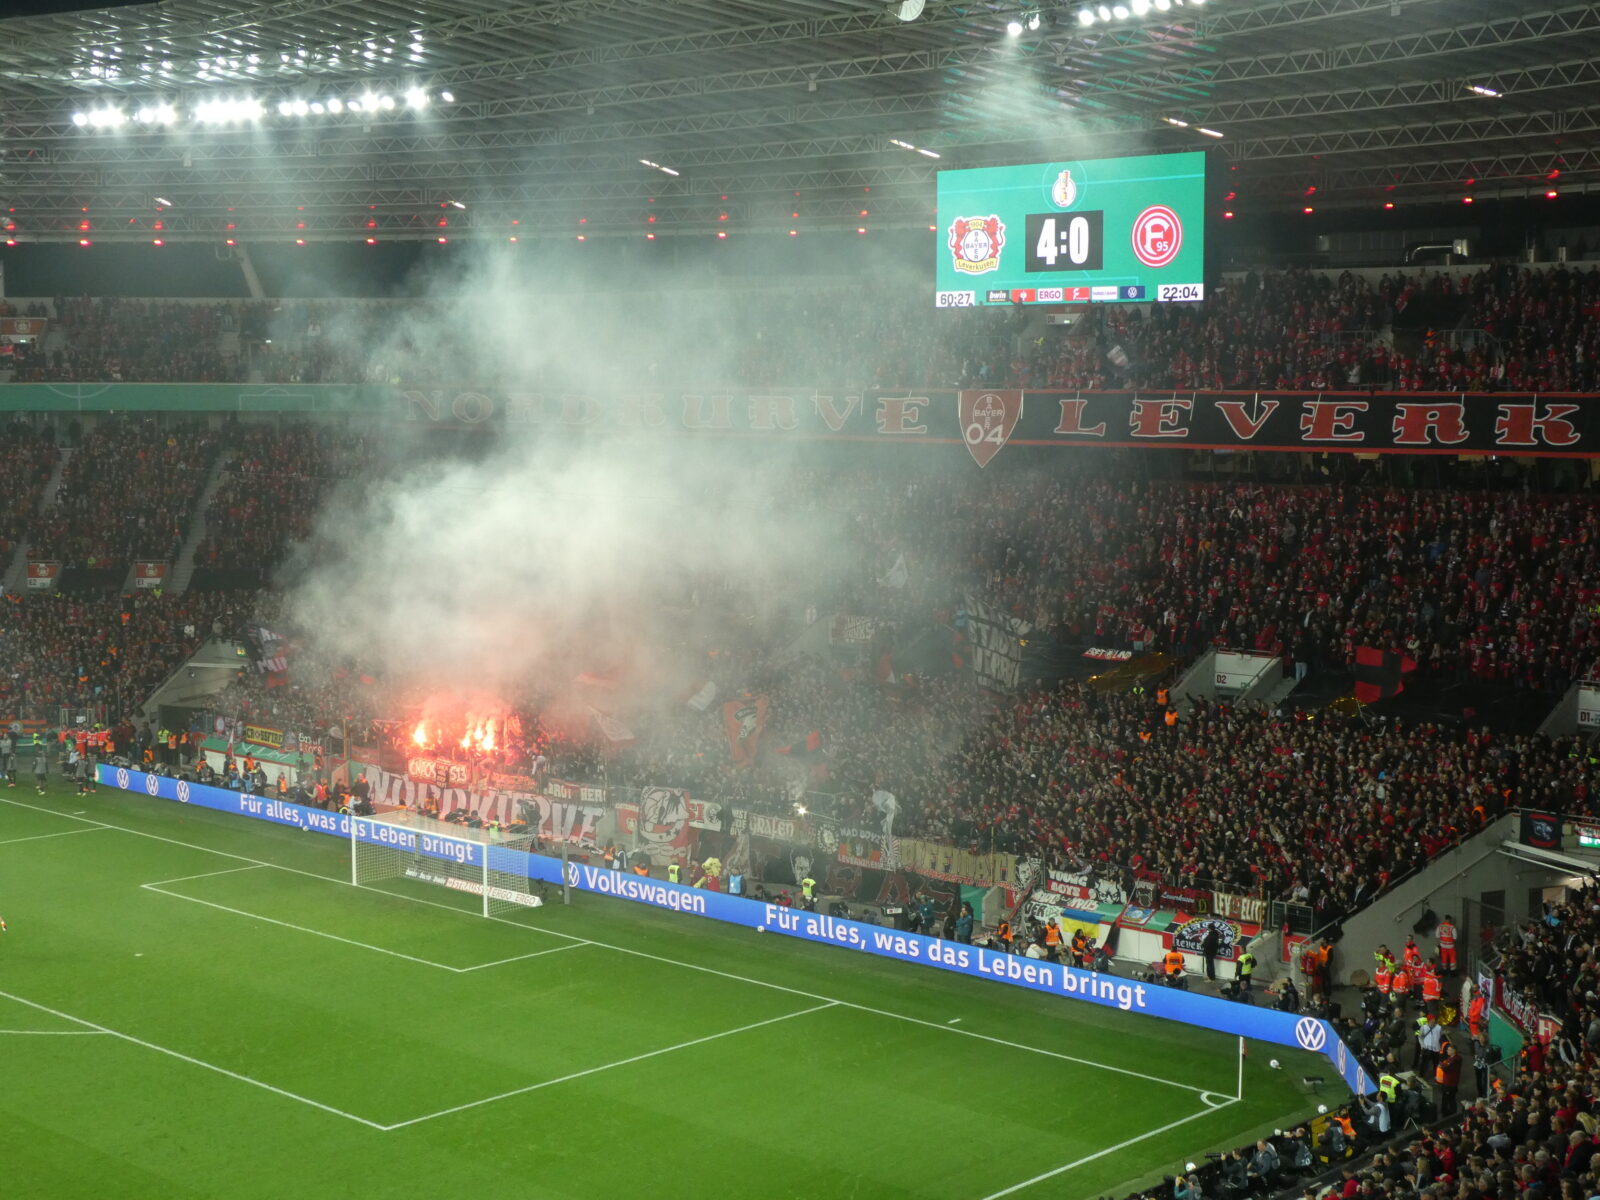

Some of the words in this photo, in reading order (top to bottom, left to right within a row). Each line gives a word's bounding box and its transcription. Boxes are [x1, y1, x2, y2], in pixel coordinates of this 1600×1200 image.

[1036, 217, 1090, 265] 4:0
[1156, 241, 1169, 252] 95
[958, 260, 995, 271] Leverkusen
[940, 293, 971, 305] 60:27
[1039, 290, 1061, 299] ERGO
[1162, 286, 1199, 299] 22:04
[974, 409, 1003, 417] BAYER
[966, 423, 1004, 446] 04
[1216, 674, 1227, 684] D2
[239, 793, 262, 813] Für
[266, 800, 303, 825] alles,
[307, 812, 336, 830] was
[341, 815, 365, 836] das
[371, 822, 416, 848] Leben
[1047, 869, 1088, 887] YOUNG
[583, 865, 706, 914] Volkswagen
[1050, 881, 1081, 897] BOYS
[515, 893, 536, 905] ERGO
[766, 904, 799, 931] Für
[806, 915, 866, 950] alles,
[874, 932, 920, 957] was
[927, 939, 969, 968] das
[978, 949, 1053, 986] Leben
[1063, 966, 1146, 1011] bringt
